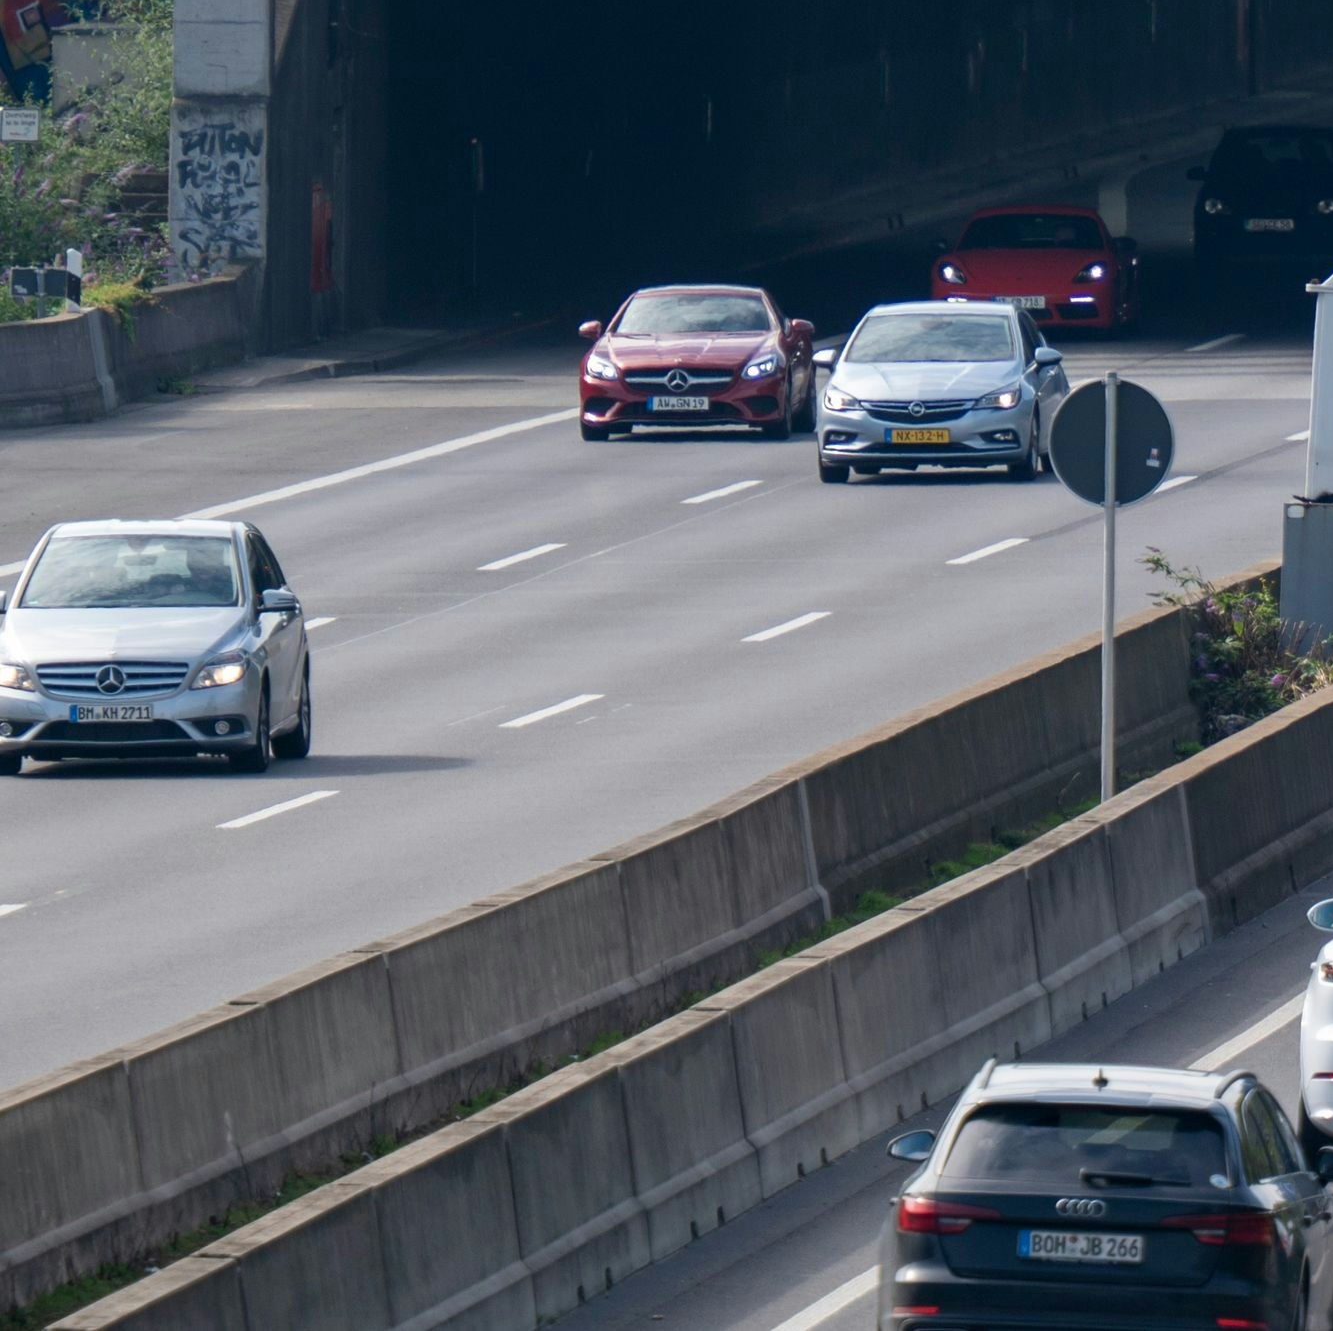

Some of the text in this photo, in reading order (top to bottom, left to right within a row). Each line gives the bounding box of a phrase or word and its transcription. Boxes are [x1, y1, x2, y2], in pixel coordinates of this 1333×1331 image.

[692, 398, 705, 408] 19
[896, 430, 944, 441] NX-132-H
[78, 706, 150, 720] BM KH 2711
[1032, 1233, 1139, 1257] BOH JB 266
